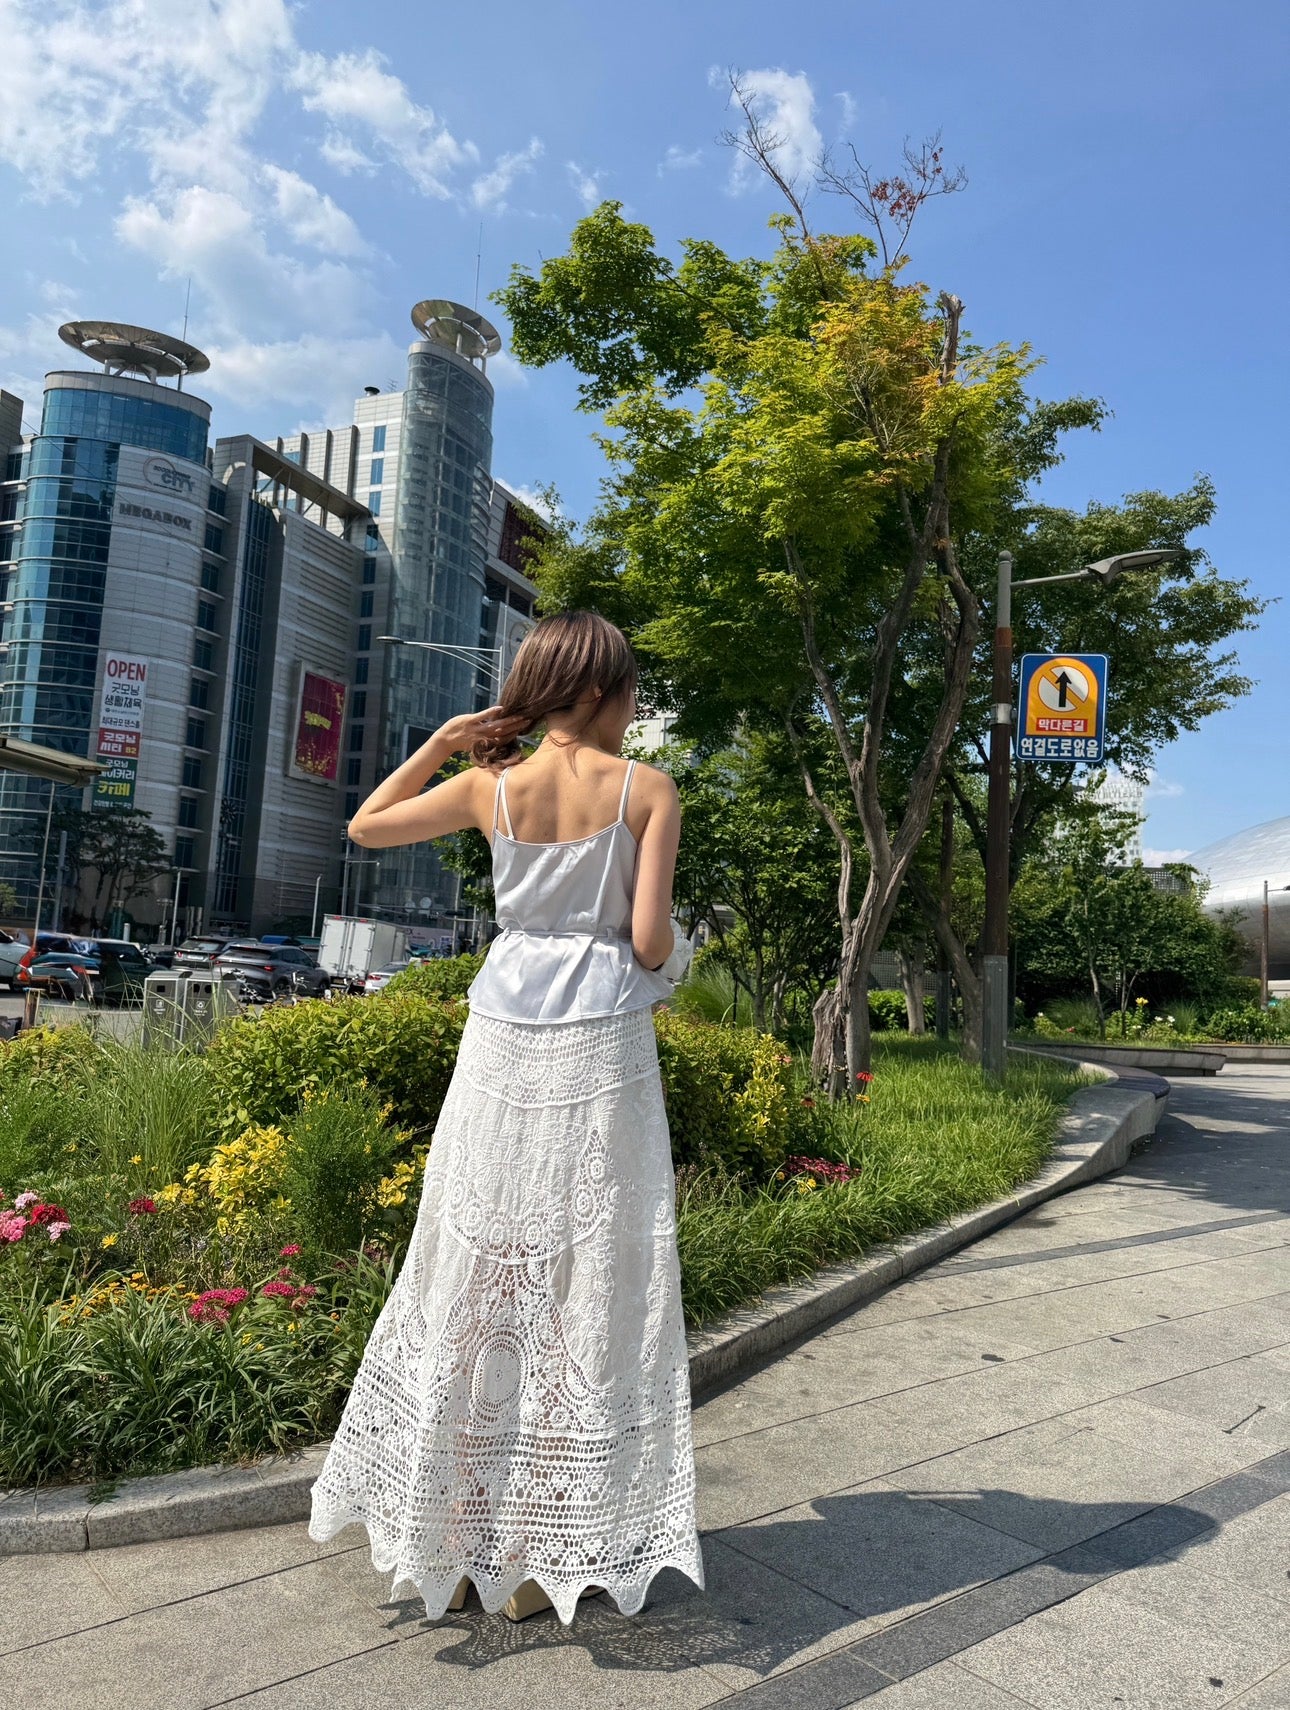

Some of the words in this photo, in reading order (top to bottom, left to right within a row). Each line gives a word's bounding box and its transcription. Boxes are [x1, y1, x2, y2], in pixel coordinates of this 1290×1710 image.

[119, 503, 192, 531] MEGABOX
[107, 659, 146, 681] OPEN
[112, 682, 140, 696] 굿모닝
[1038, 719, 1084, 732] 막다른길
[104, 732, 136, 744] 굿모닝
[1021, 737, 1099, 758] 연결도로없음
[97, 780, 131, 797] 카페
